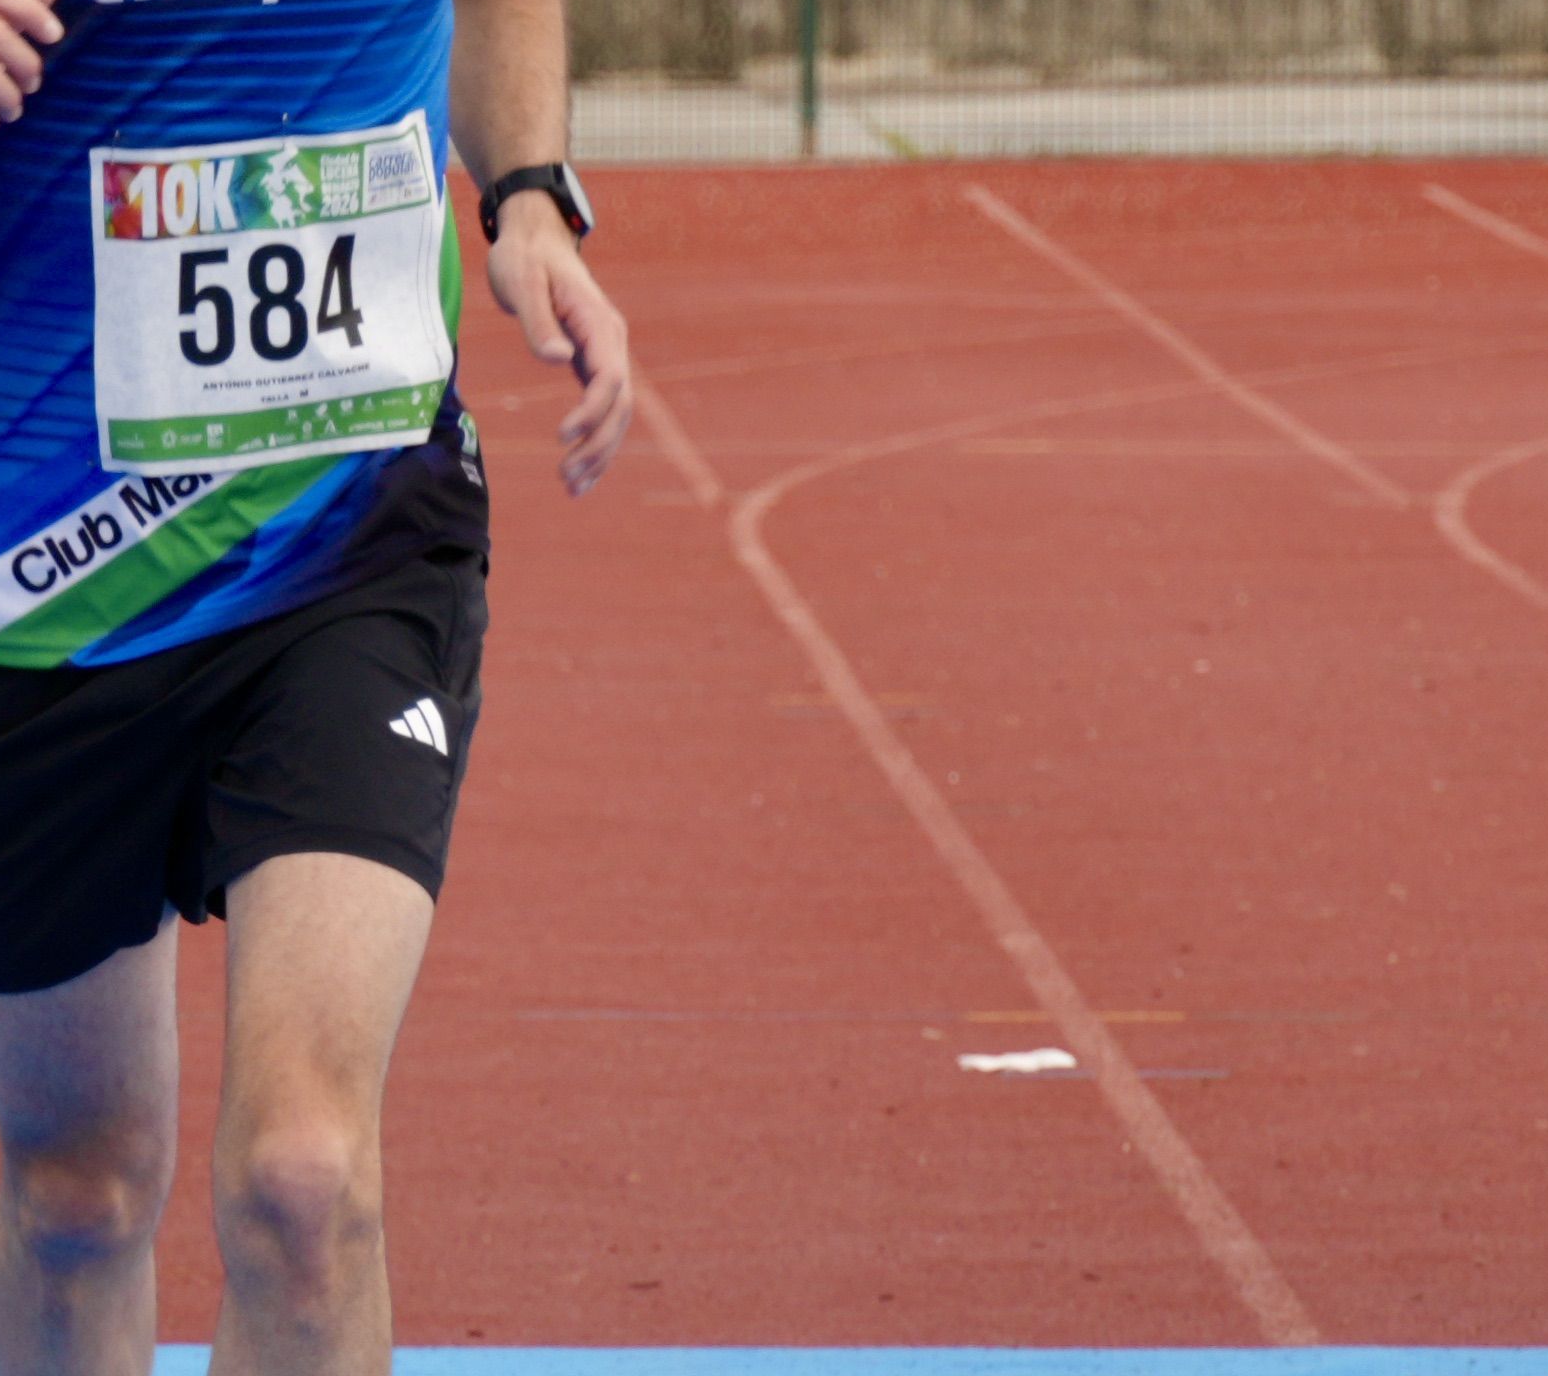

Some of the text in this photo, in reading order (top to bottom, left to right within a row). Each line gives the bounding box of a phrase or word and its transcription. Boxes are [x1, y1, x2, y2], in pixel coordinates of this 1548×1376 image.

[128, 159, 238, 238] 10K
[178, 232, 364, 366] 584
[203, 380, 252, 392] ANTONIO
[11, 513, 123, 594] Club
